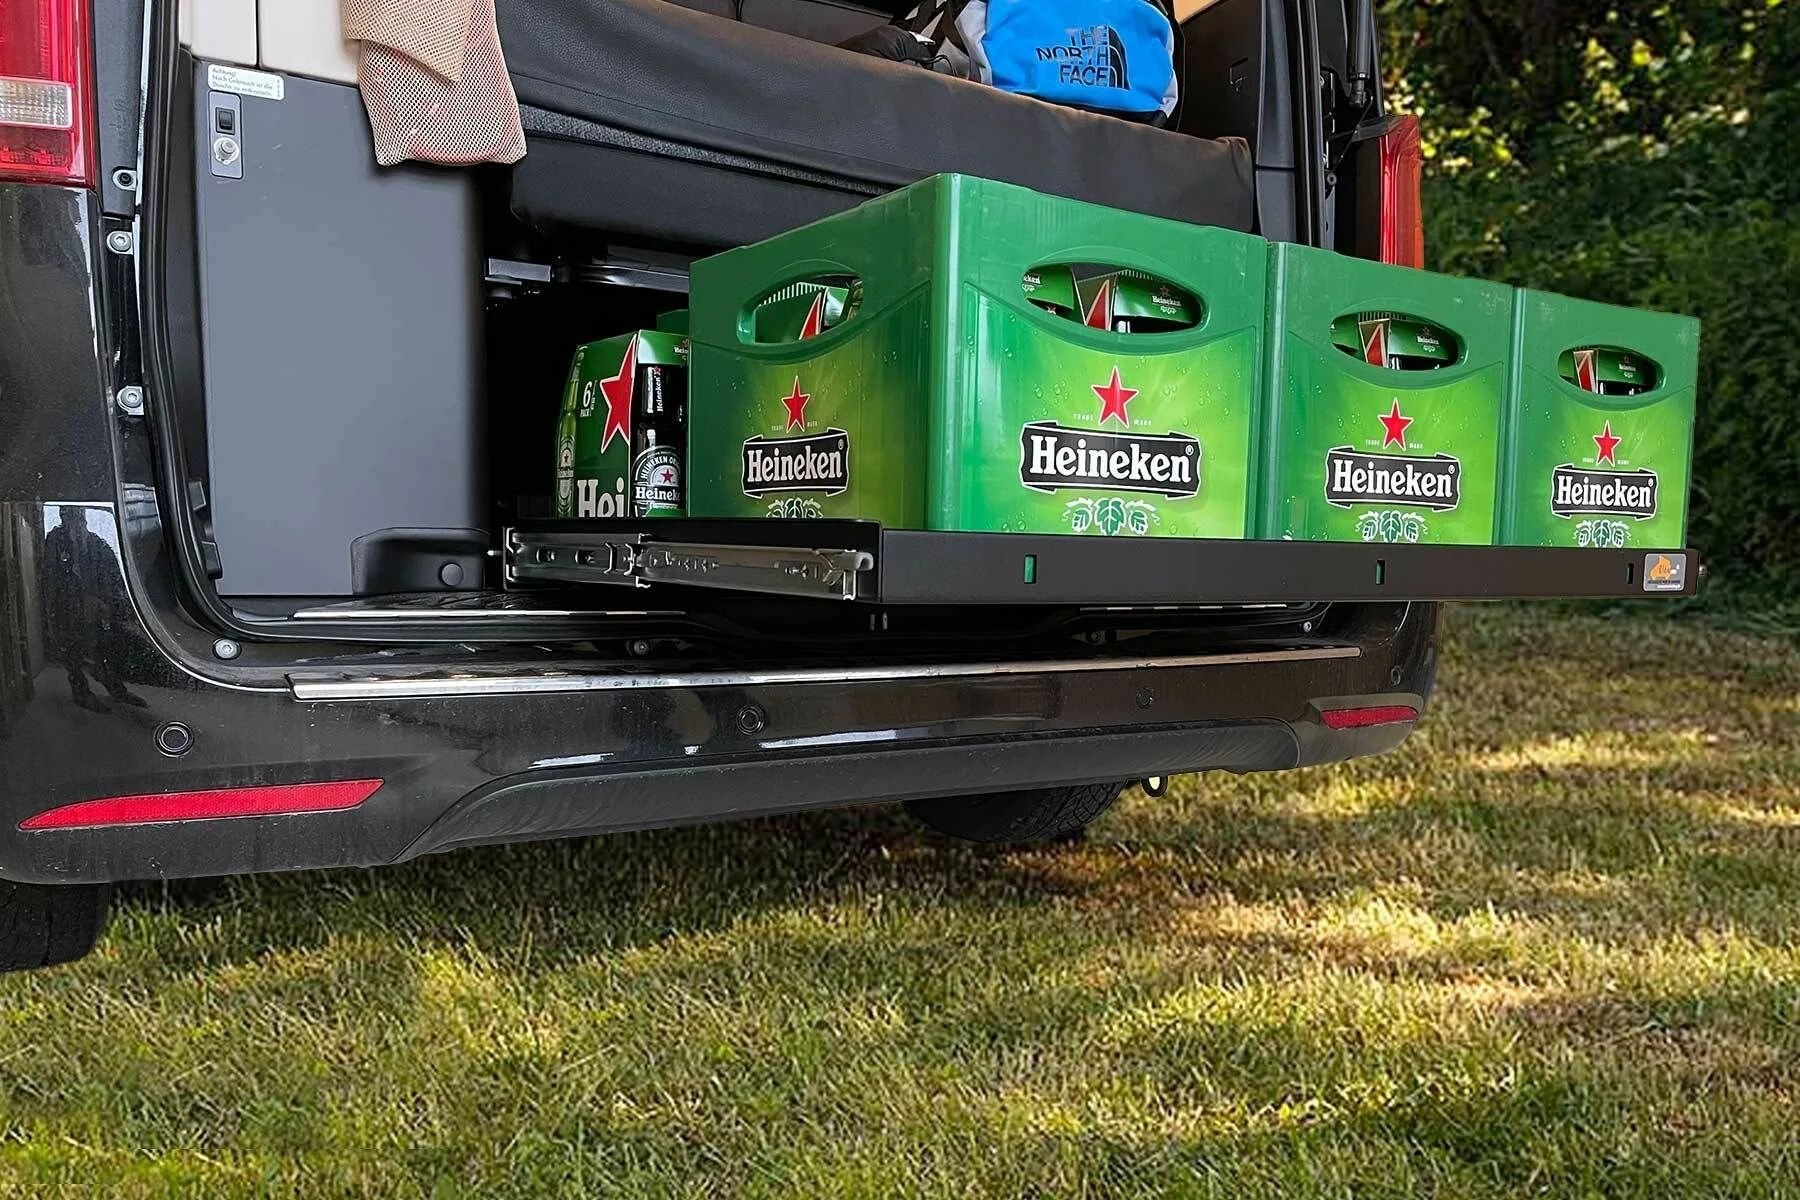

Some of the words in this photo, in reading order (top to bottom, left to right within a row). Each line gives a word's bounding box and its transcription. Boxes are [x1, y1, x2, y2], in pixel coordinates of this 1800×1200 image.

[1066, 26, 1108, 46] THE
[1036, 46, 1108, 66] NORTH
[1060, 64, 1108, 87] FACE
[583, 380, 593, 407] 6
[747, 446, 843, 482] Heineken
[1030, 434, 1192, 483] Heineken
[1332, 458, 1453, 498] Heineken
[1555, 475, 1652, 508] Heineken
